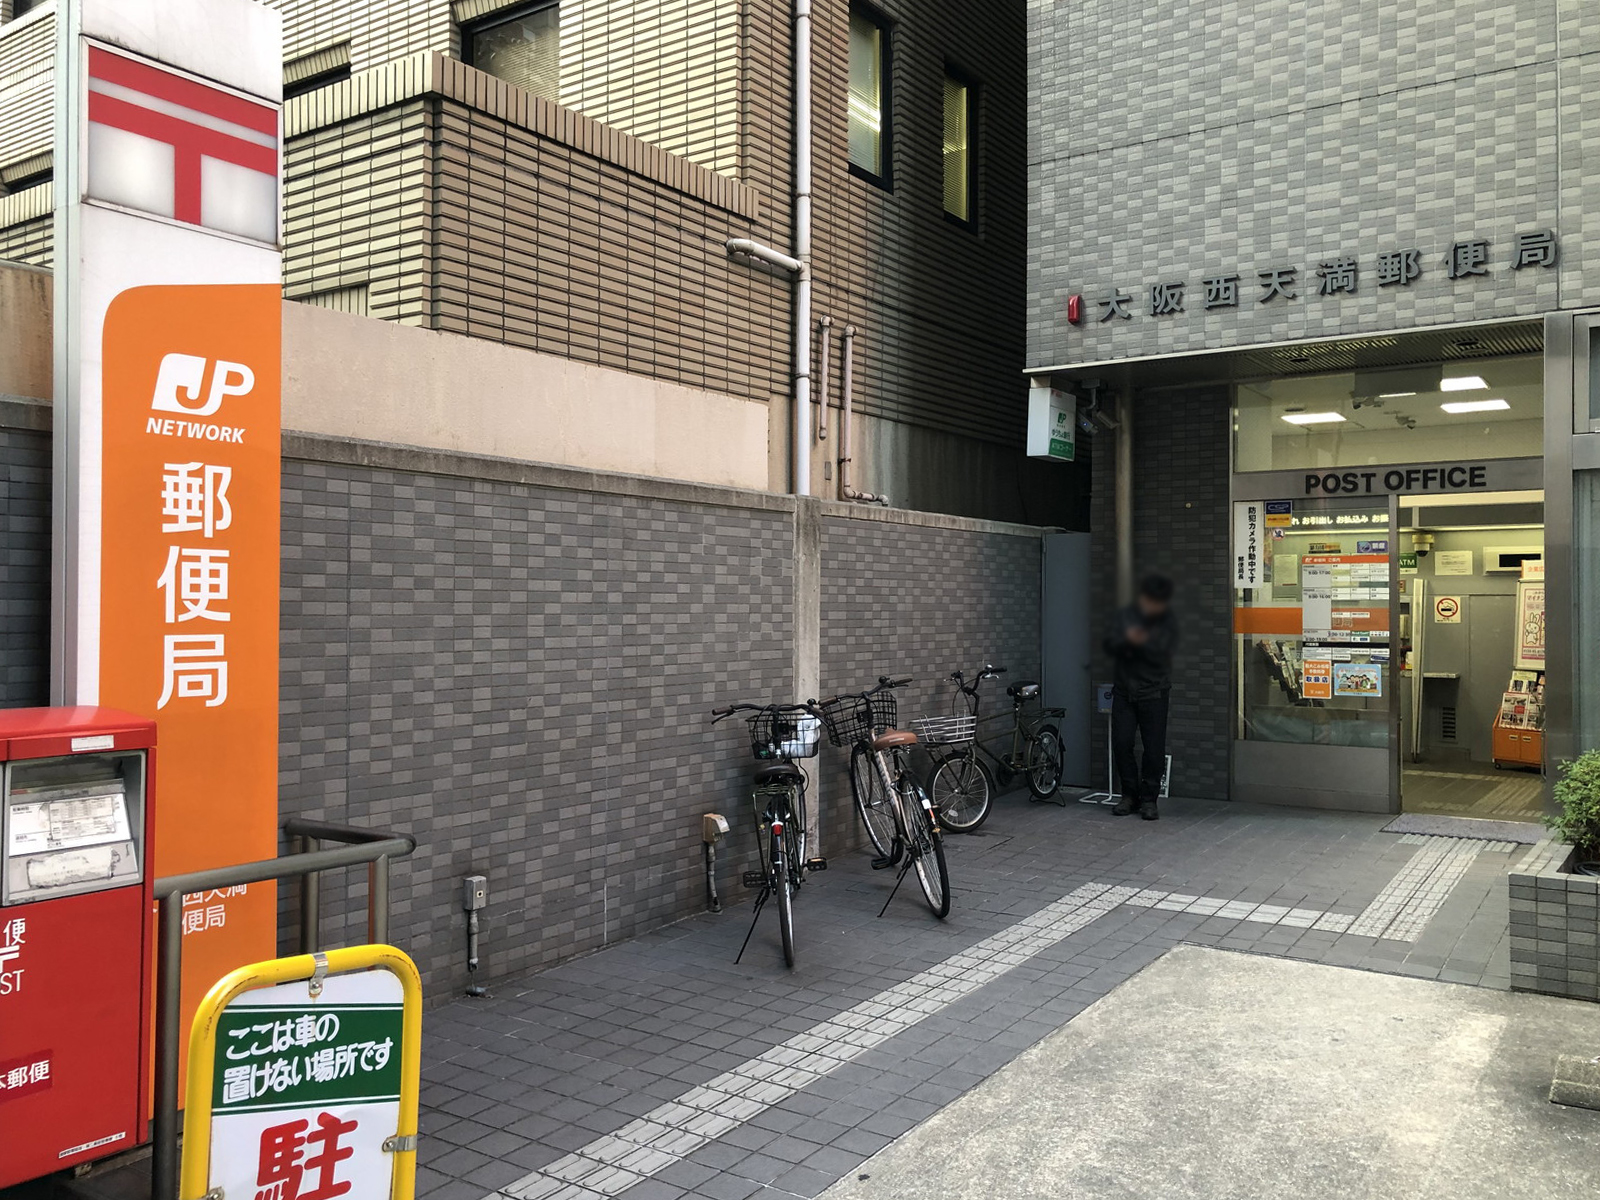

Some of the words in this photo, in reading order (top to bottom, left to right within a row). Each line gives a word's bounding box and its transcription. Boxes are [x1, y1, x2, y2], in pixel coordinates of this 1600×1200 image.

[1099, 230, 1559, 322] 大阪西天満郵便局
[146, 418, 245, 444] NETWORK
[1305, 473, 1376, 494] POST
[1384, 466, 1487, 490] OFFICE
[1247, 506, 1257, 584] 防犯カメラ作動中です
[1301, 515, 1334, 525] お引出し
[1335, 514, 1369, 524] お払込み
[157, 461, 232, 710] 郵便局
[226, 1013, 340, 1060] ここは車の
[222, 1037, 394, 1105] 置けない場所です
[255, 1112, 359, 1200] 駐
